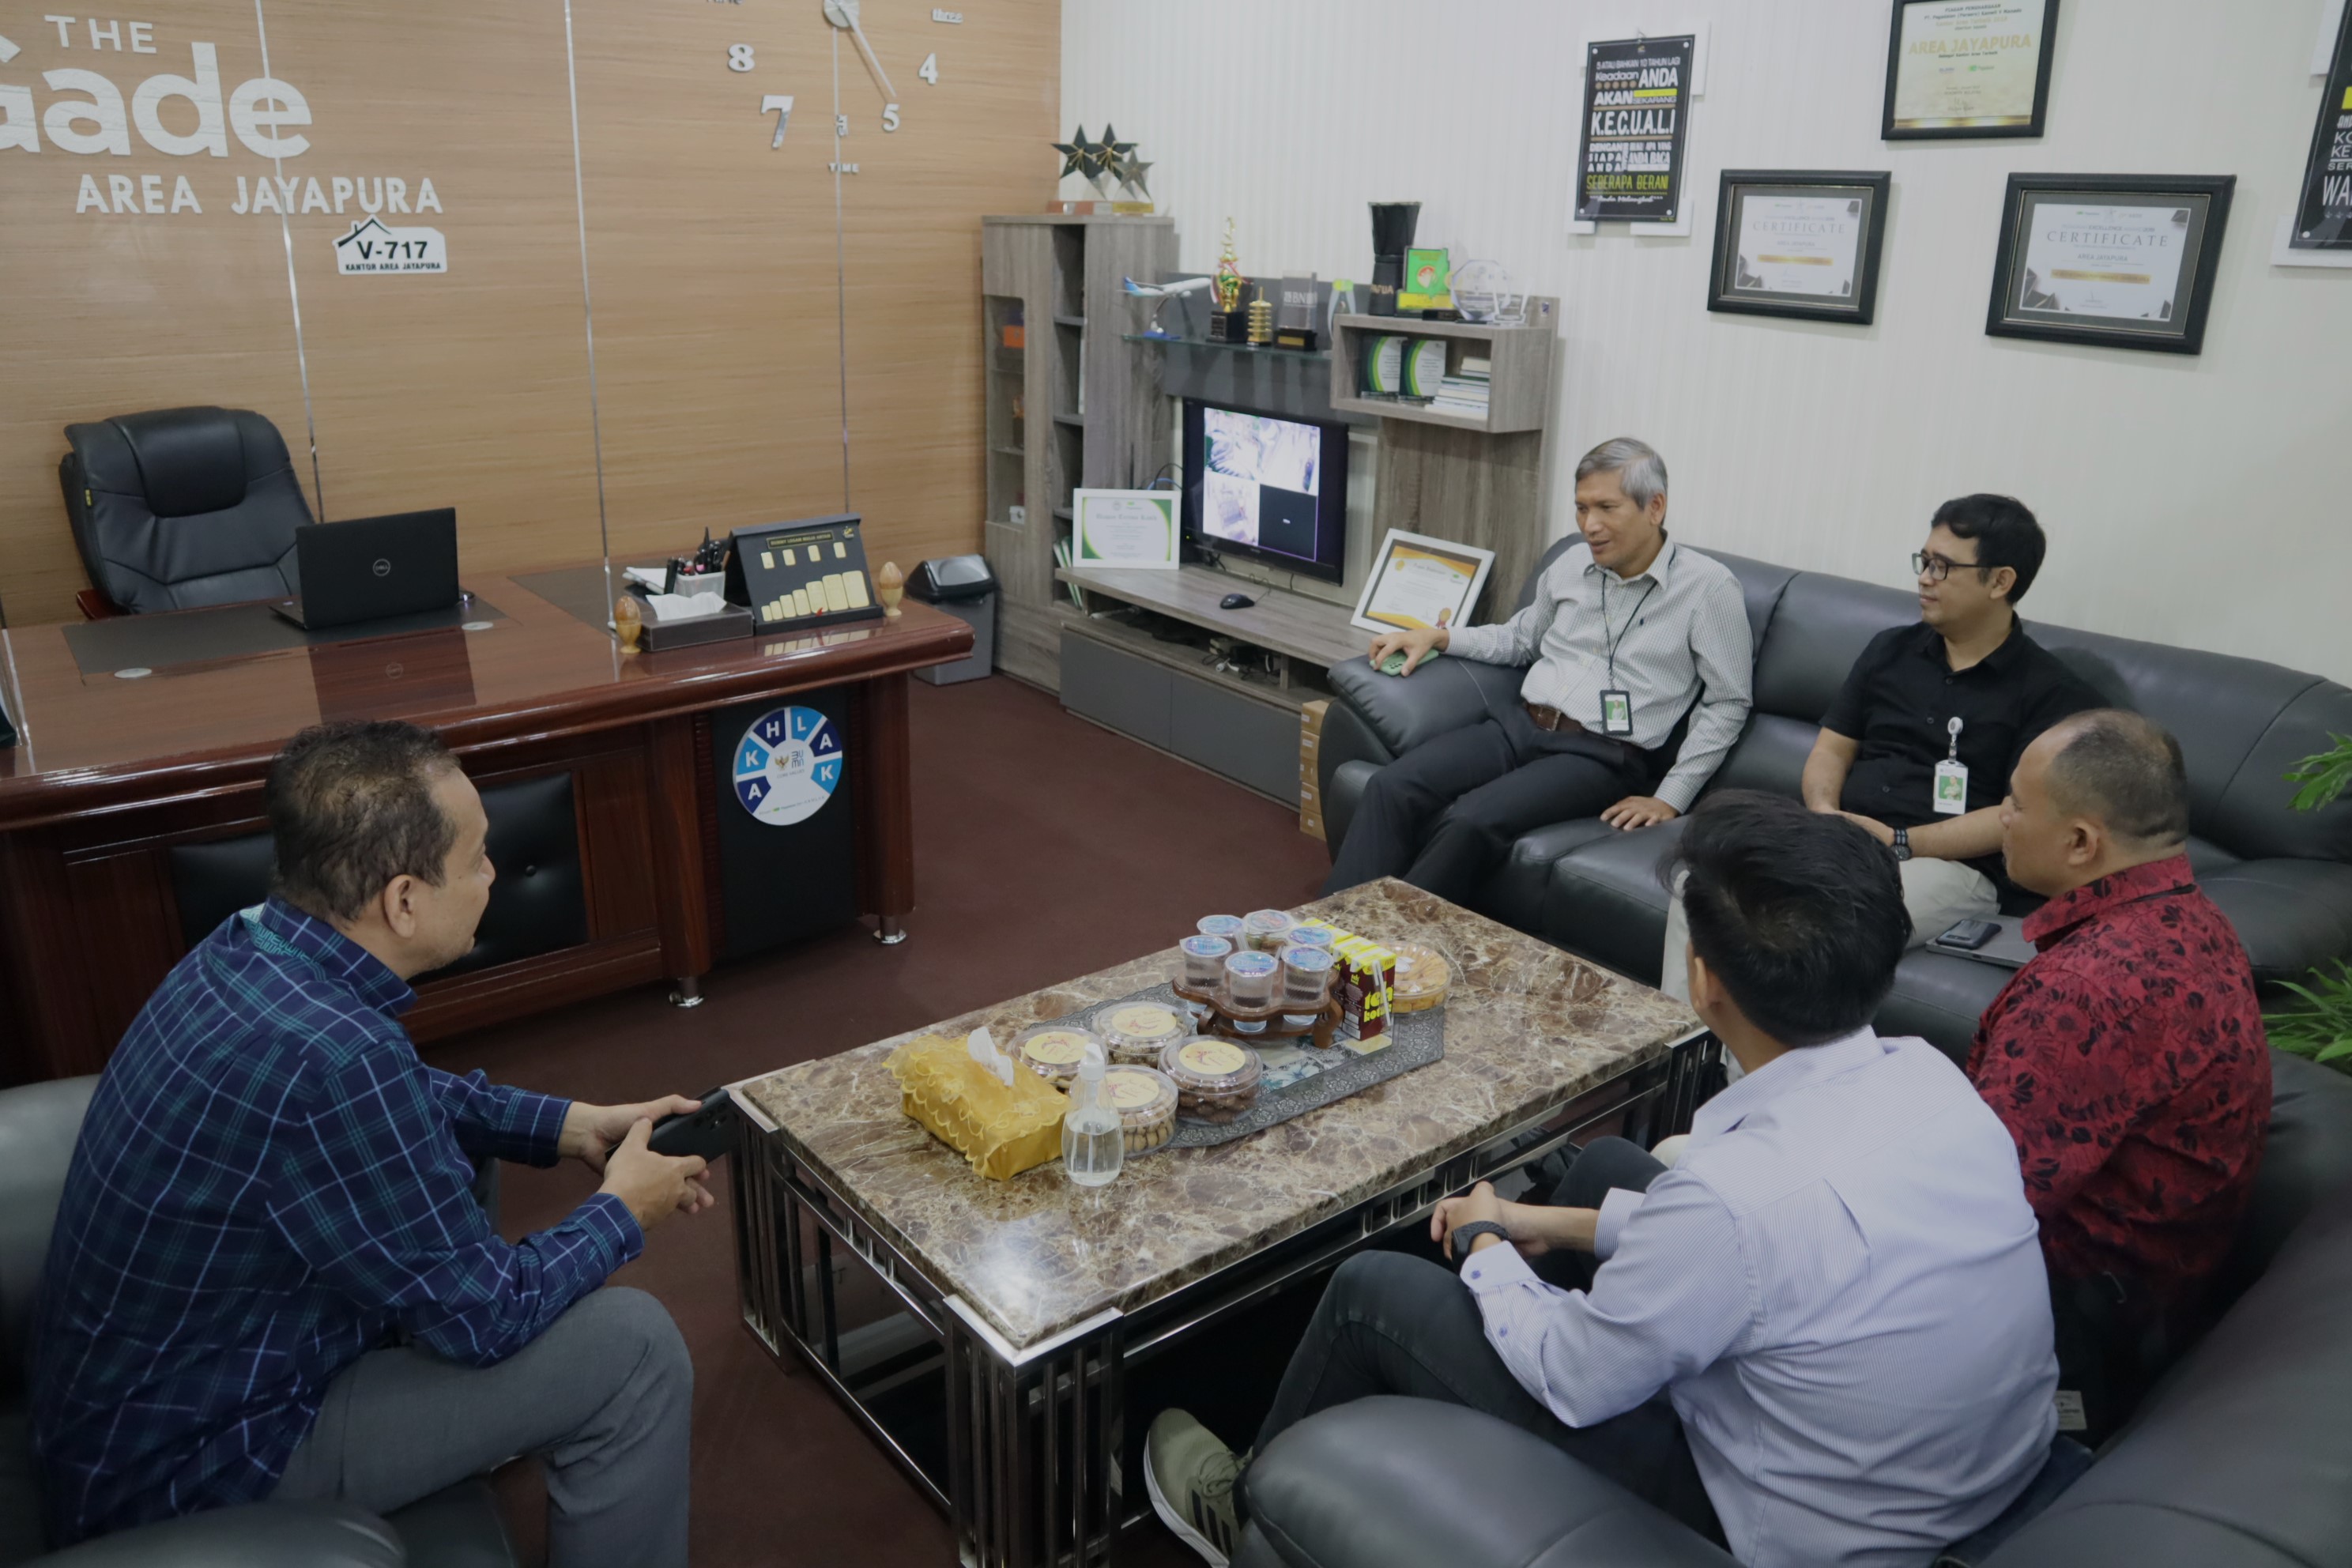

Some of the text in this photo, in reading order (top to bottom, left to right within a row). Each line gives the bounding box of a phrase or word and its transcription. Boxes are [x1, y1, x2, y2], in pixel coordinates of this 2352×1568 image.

[44, 14, 156, 54] THE
[1909, 33, 2031, 55] AREA JAYAPURA
[728, 43, 755, 72] 8
[918, 53, 938, 85] 4
[1638, 67, 1679, 89] ANDA
[1593, 90, 1633, 106] AKAN
[760, 95, 794, 149] 7
[882, 104, 900, 132] 5
[1591, 109, 1675, 136] K.E.C.U.A.L.I
[829, 162, 860, 173] TIME
[1586, 175, 1669, 190] SEBERAPA BERANI
[76, 174, 443, 214] AREA JAYAPURA
[1753, 220, 1846, 234] CERTIFICATE
[2047, 231, 2169, 247] CERTIFICATE
[356, 241, 428, 260] V-717
